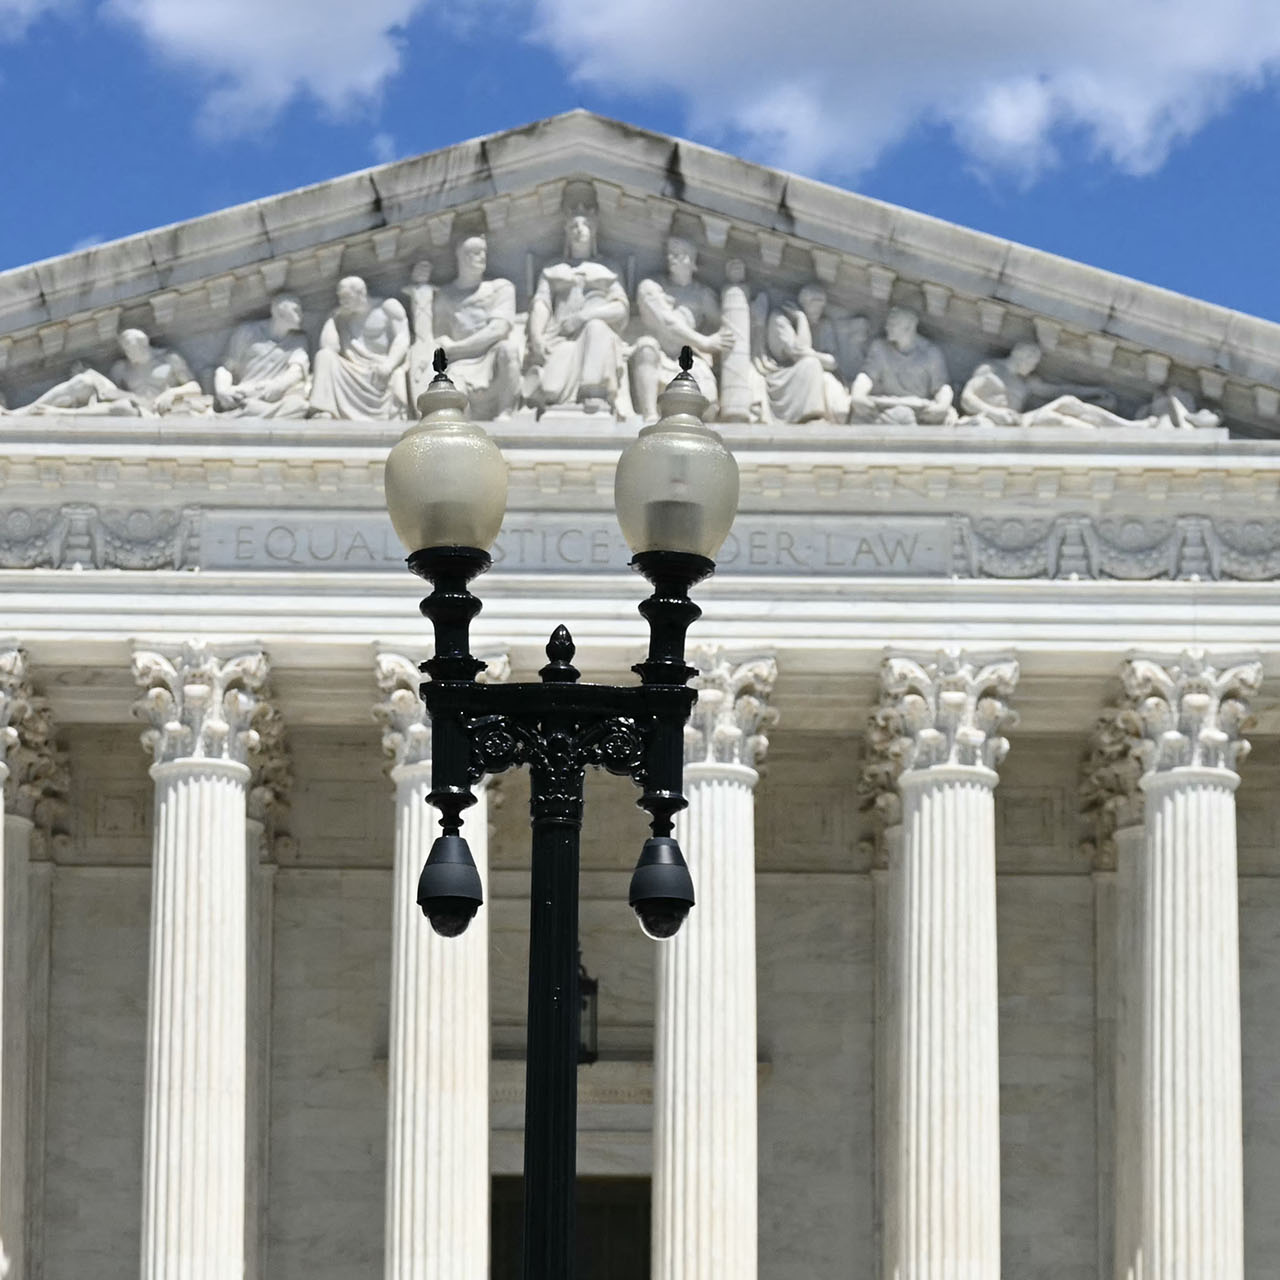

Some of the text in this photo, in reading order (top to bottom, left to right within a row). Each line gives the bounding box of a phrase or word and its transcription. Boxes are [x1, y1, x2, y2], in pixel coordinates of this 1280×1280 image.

[234, 525, 405, 564] EQUAL
[715, 530, 809, 567] DER
[824, 531, 920, 567] LAW
